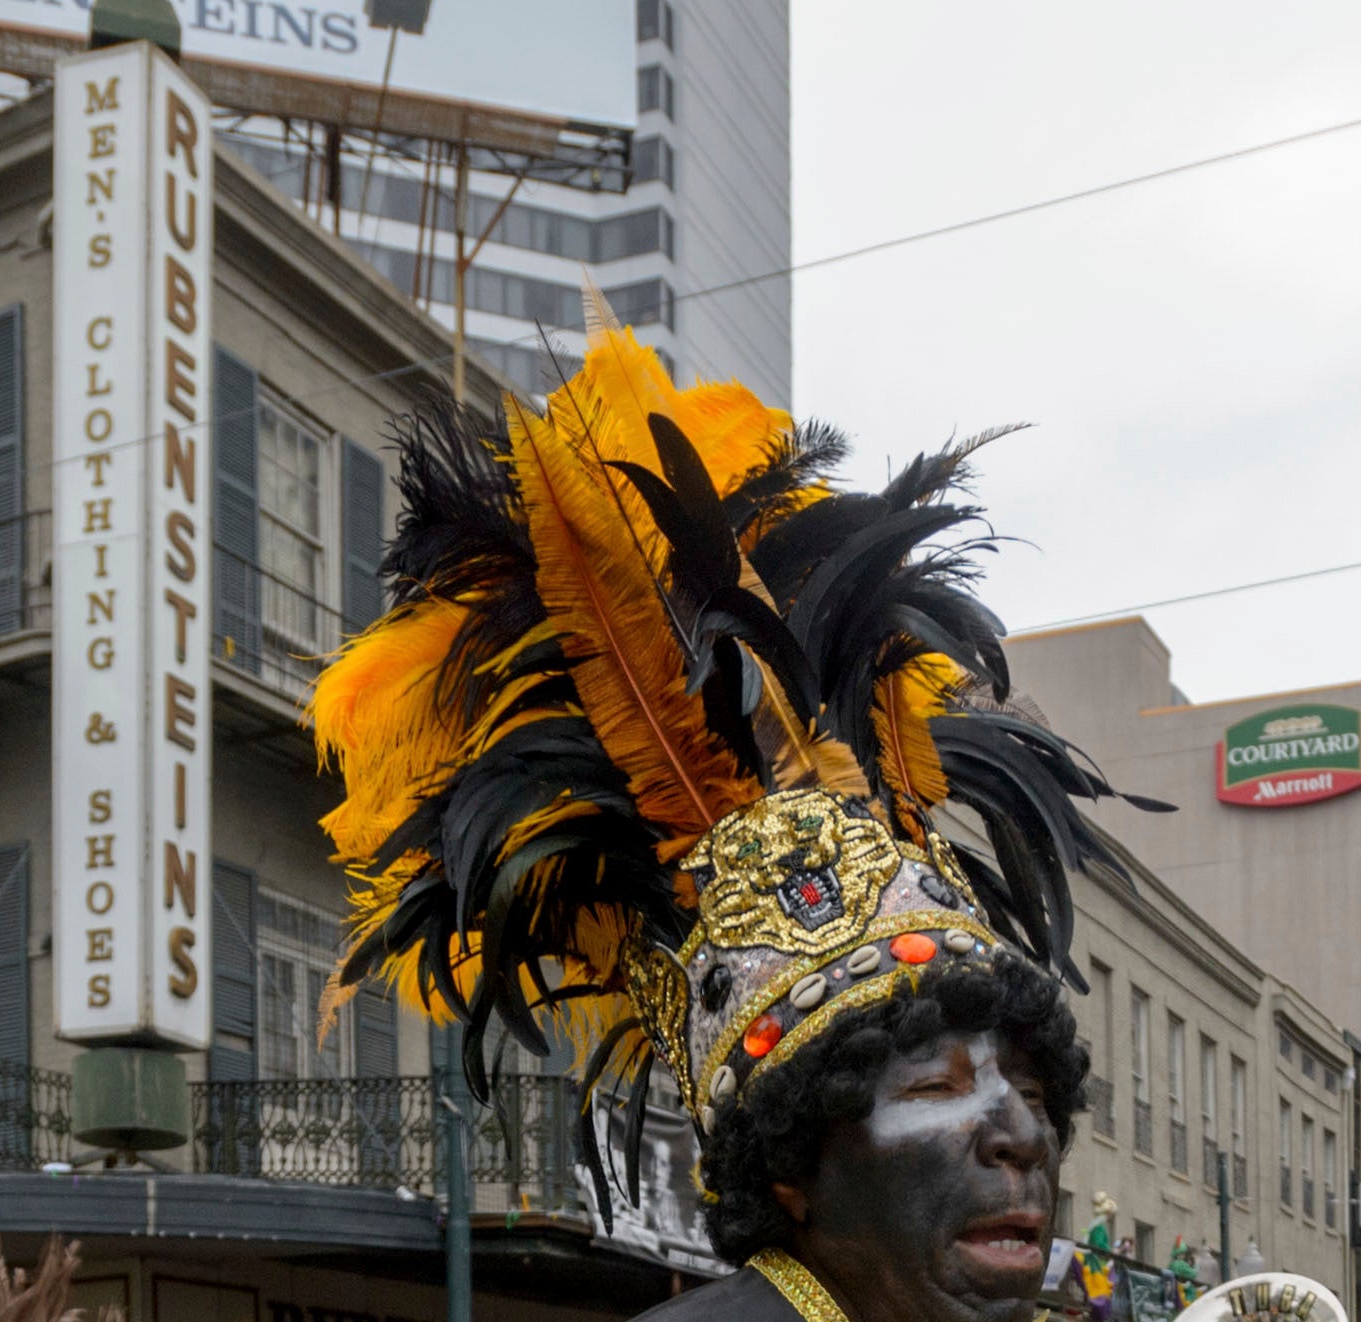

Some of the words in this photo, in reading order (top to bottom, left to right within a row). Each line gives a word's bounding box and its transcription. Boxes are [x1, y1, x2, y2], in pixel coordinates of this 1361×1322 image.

[84, 77, 120, 270] MEN'S
[83, 317, 115, 671] CLOTHING
[165, 86, 199, 1000] RUBENSTEINS
[84, 712, 117, 746] &
[1227, 732, 1360, 767] COURTYARD
[1253, 772, 1334, 801] Marriott
[84, 790, 116, 1009] SHOES
[1229, 1283, 1318, 1320] TUBA
